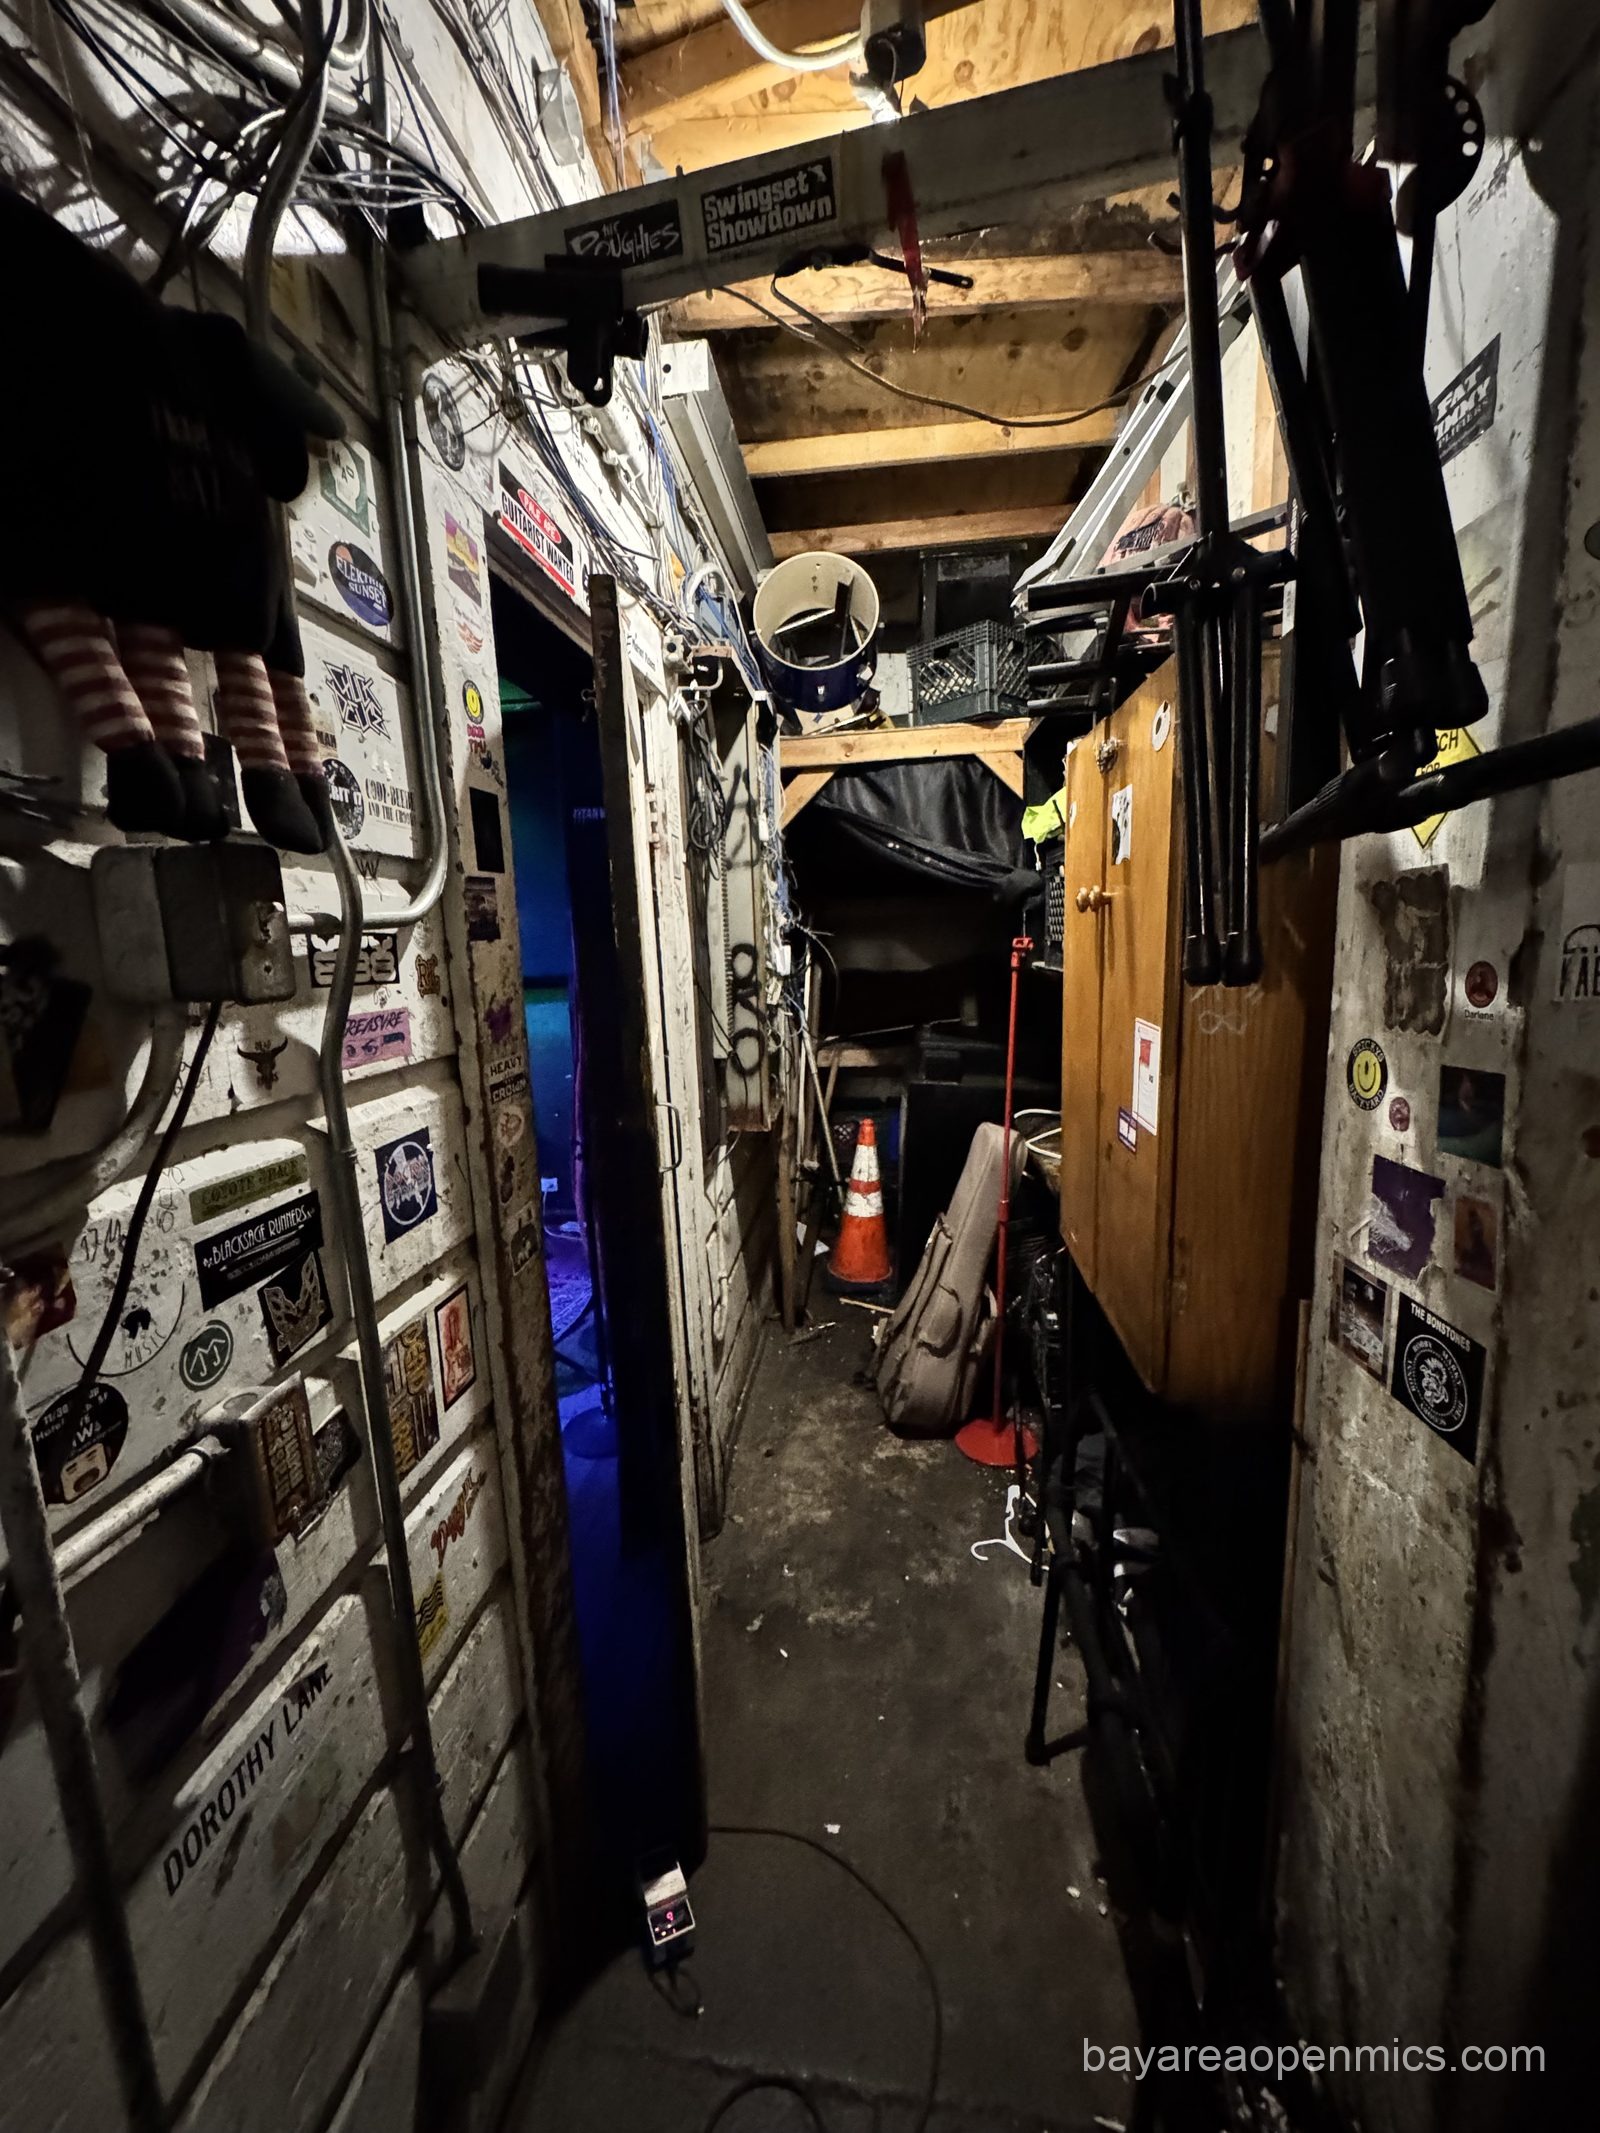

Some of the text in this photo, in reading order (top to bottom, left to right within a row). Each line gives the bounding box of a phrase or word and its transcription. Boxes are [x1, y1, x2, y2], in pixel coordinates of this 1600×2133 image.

[703, 170, 809, 222] Swingset
[707, 195, 832, 249] Showdown
[1433, 376, 1491, 441] IMMY
[1437, 364, 1483, 422] FAT
[502, 491, 574, 586] GUITARIST WANTED
[349, 581, 386, 608] SUNSET
[1464, 1009, 1494, 1021] Darlene
[491, 1056, 521, 1077] HEAVY
[492, 1079, 527, 1102] CROWN
[212, 1222, 267, 1266] BLACKSAGE
[269, 1205, 308, 1236] RUNNERS
[125, 1328, 166, 1369] MUSIC
[1410, 1302, 1471, 1352] THE BONSTONES
[163, 1721, 277, 1897] DOROTHY
